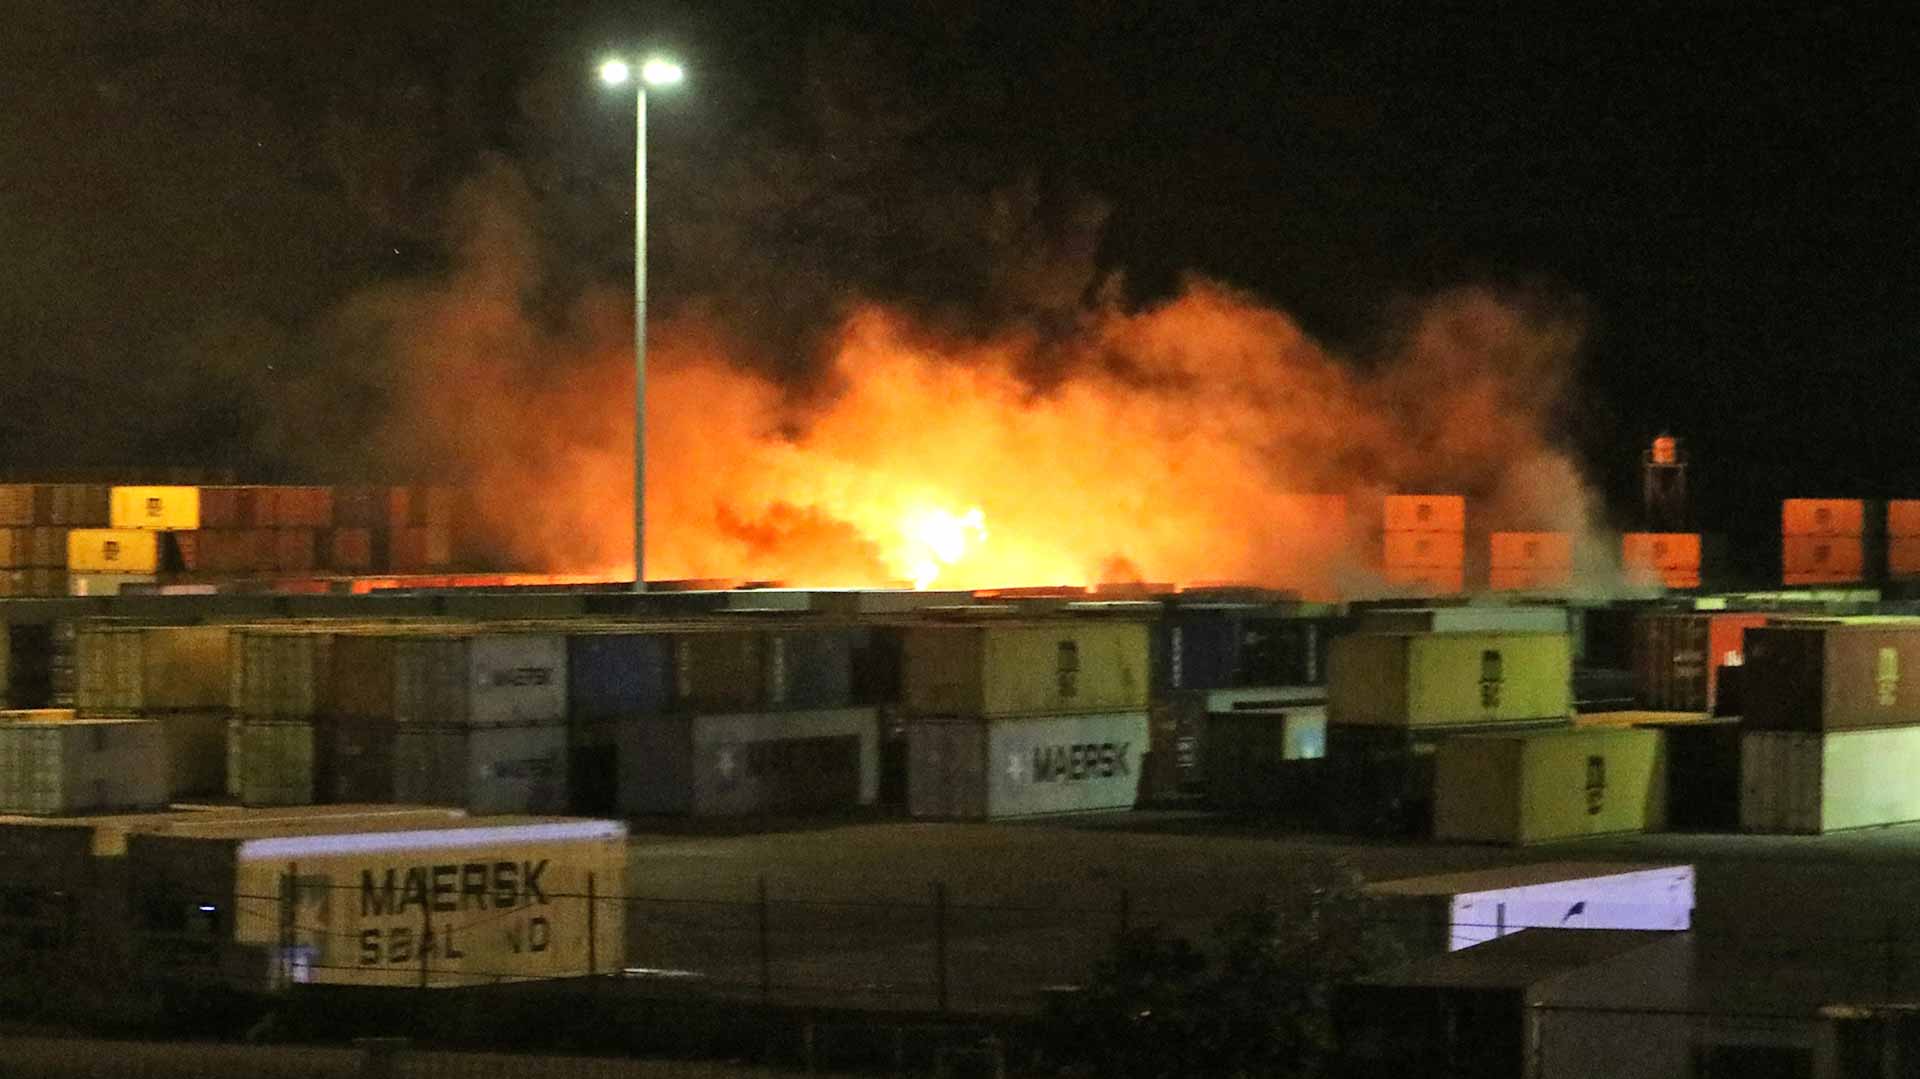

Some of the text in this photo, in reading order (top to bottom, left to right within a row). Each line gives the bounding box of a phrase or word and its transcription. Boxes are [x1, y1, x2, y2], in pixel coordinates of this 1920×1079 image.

[1032, 743, 1129, 784] MAERSK
[360, 858, 549, 917] MAERSK
[360, 916, 549, 966] SEALND
